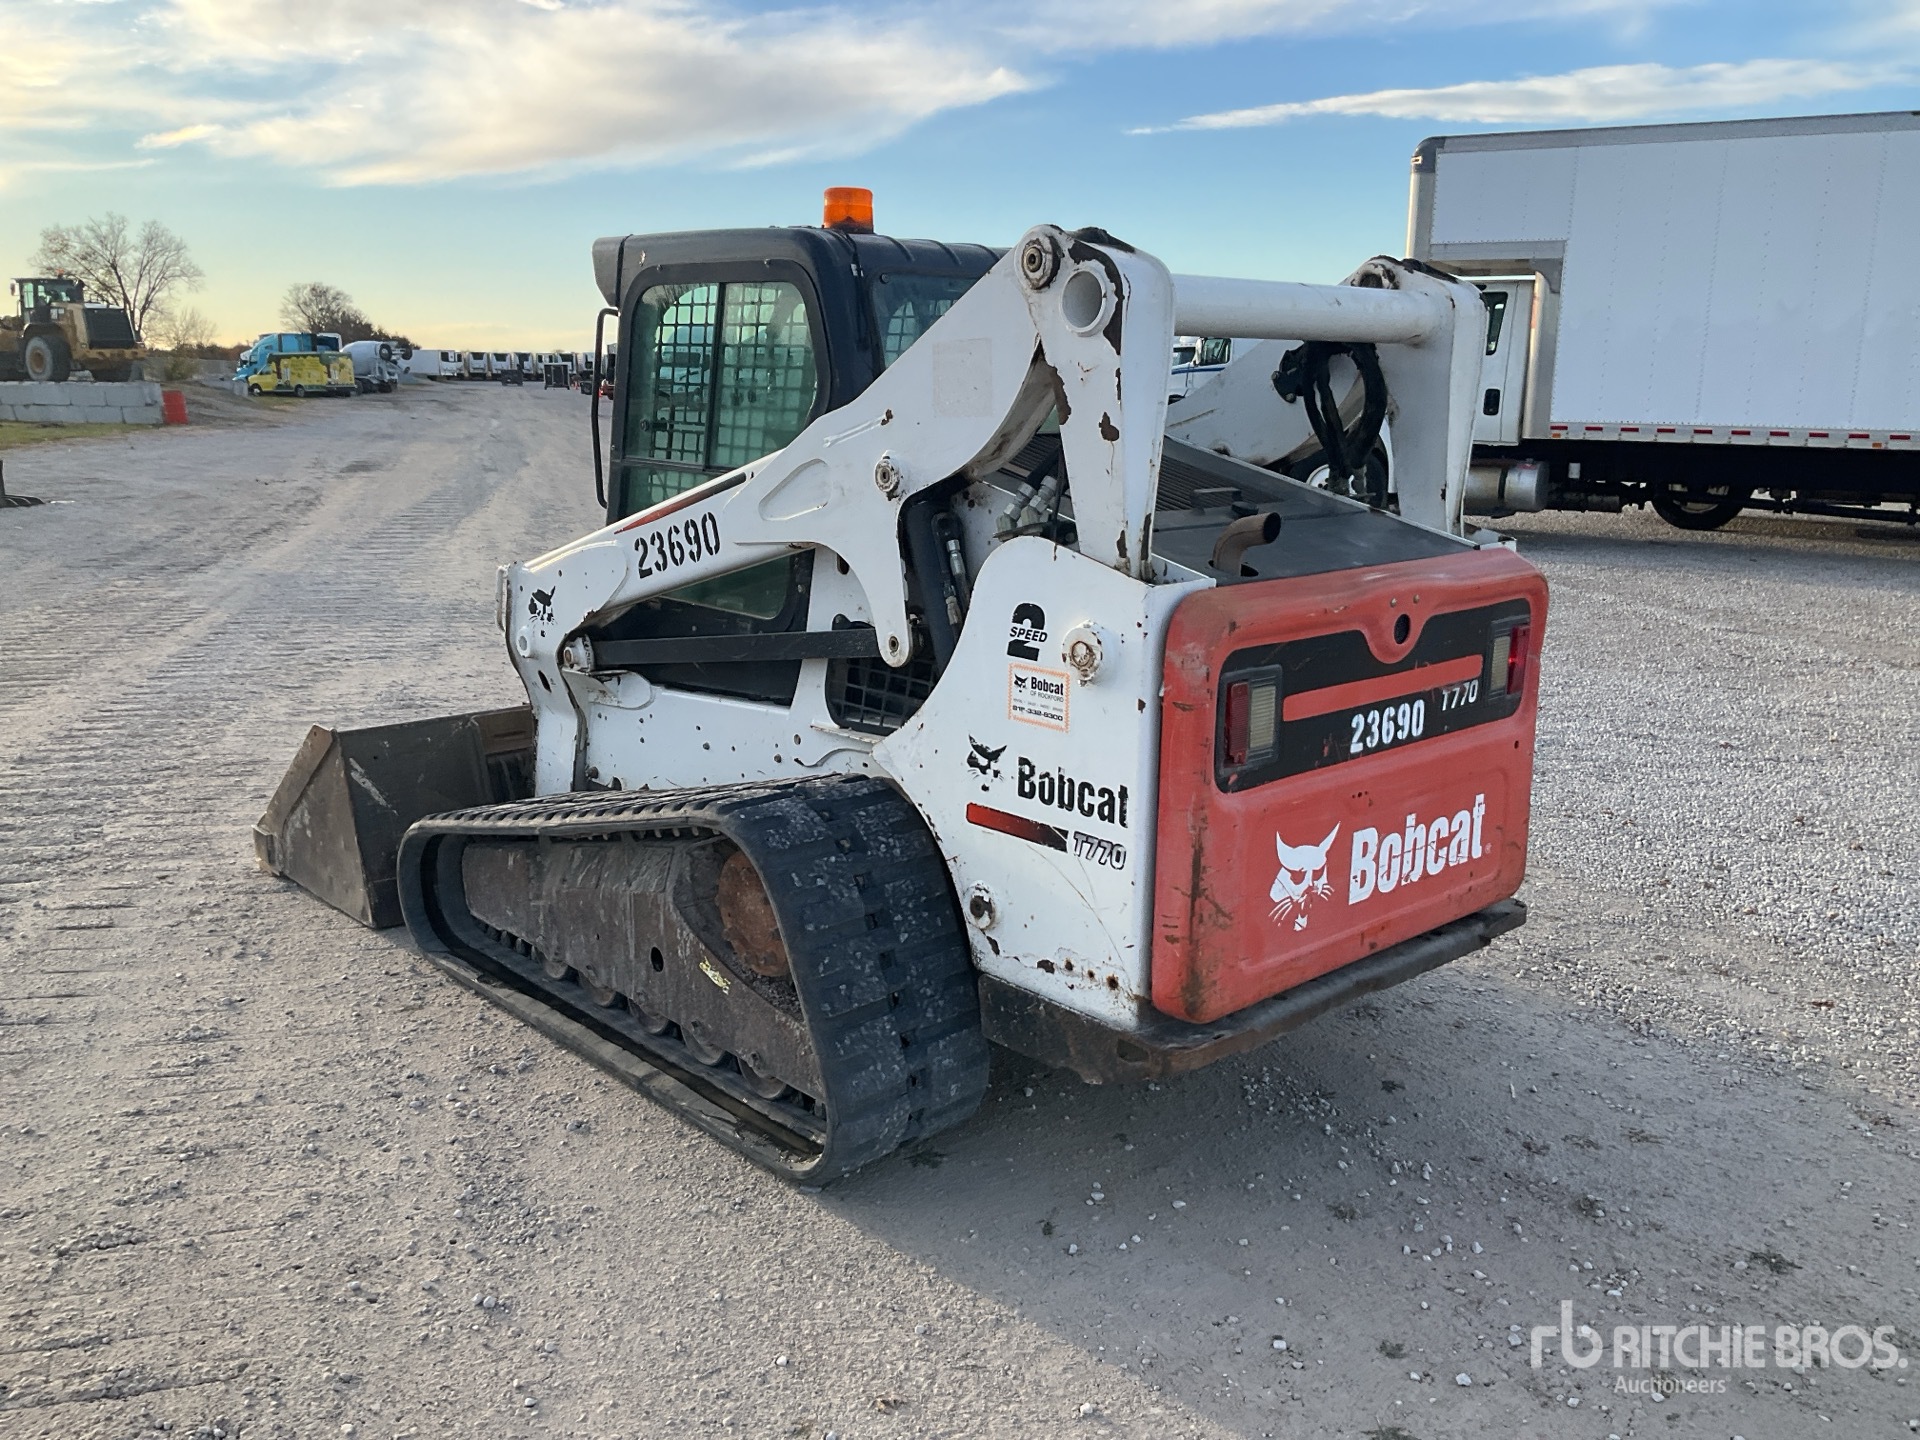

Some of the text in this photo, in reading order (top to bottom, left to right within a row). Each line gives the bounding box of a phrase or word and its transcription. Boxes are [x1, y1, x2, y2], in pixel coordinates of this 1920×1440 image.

[634, 511, 720, 579] 23690
[1007, 602, 1046, 661] 2
[1009, 626, 1048, 643] SPEED
[1030, 676, 1064, 696] Bobcat
[1442, 679, 1478, 711] T770
[1350, 699, 1425, 753] 23690
[1017, 756, 1129, 828] Bobcat
[1073, 831, 1127, 870] T770
[1349, 793, 1486, 905] Bobcat
